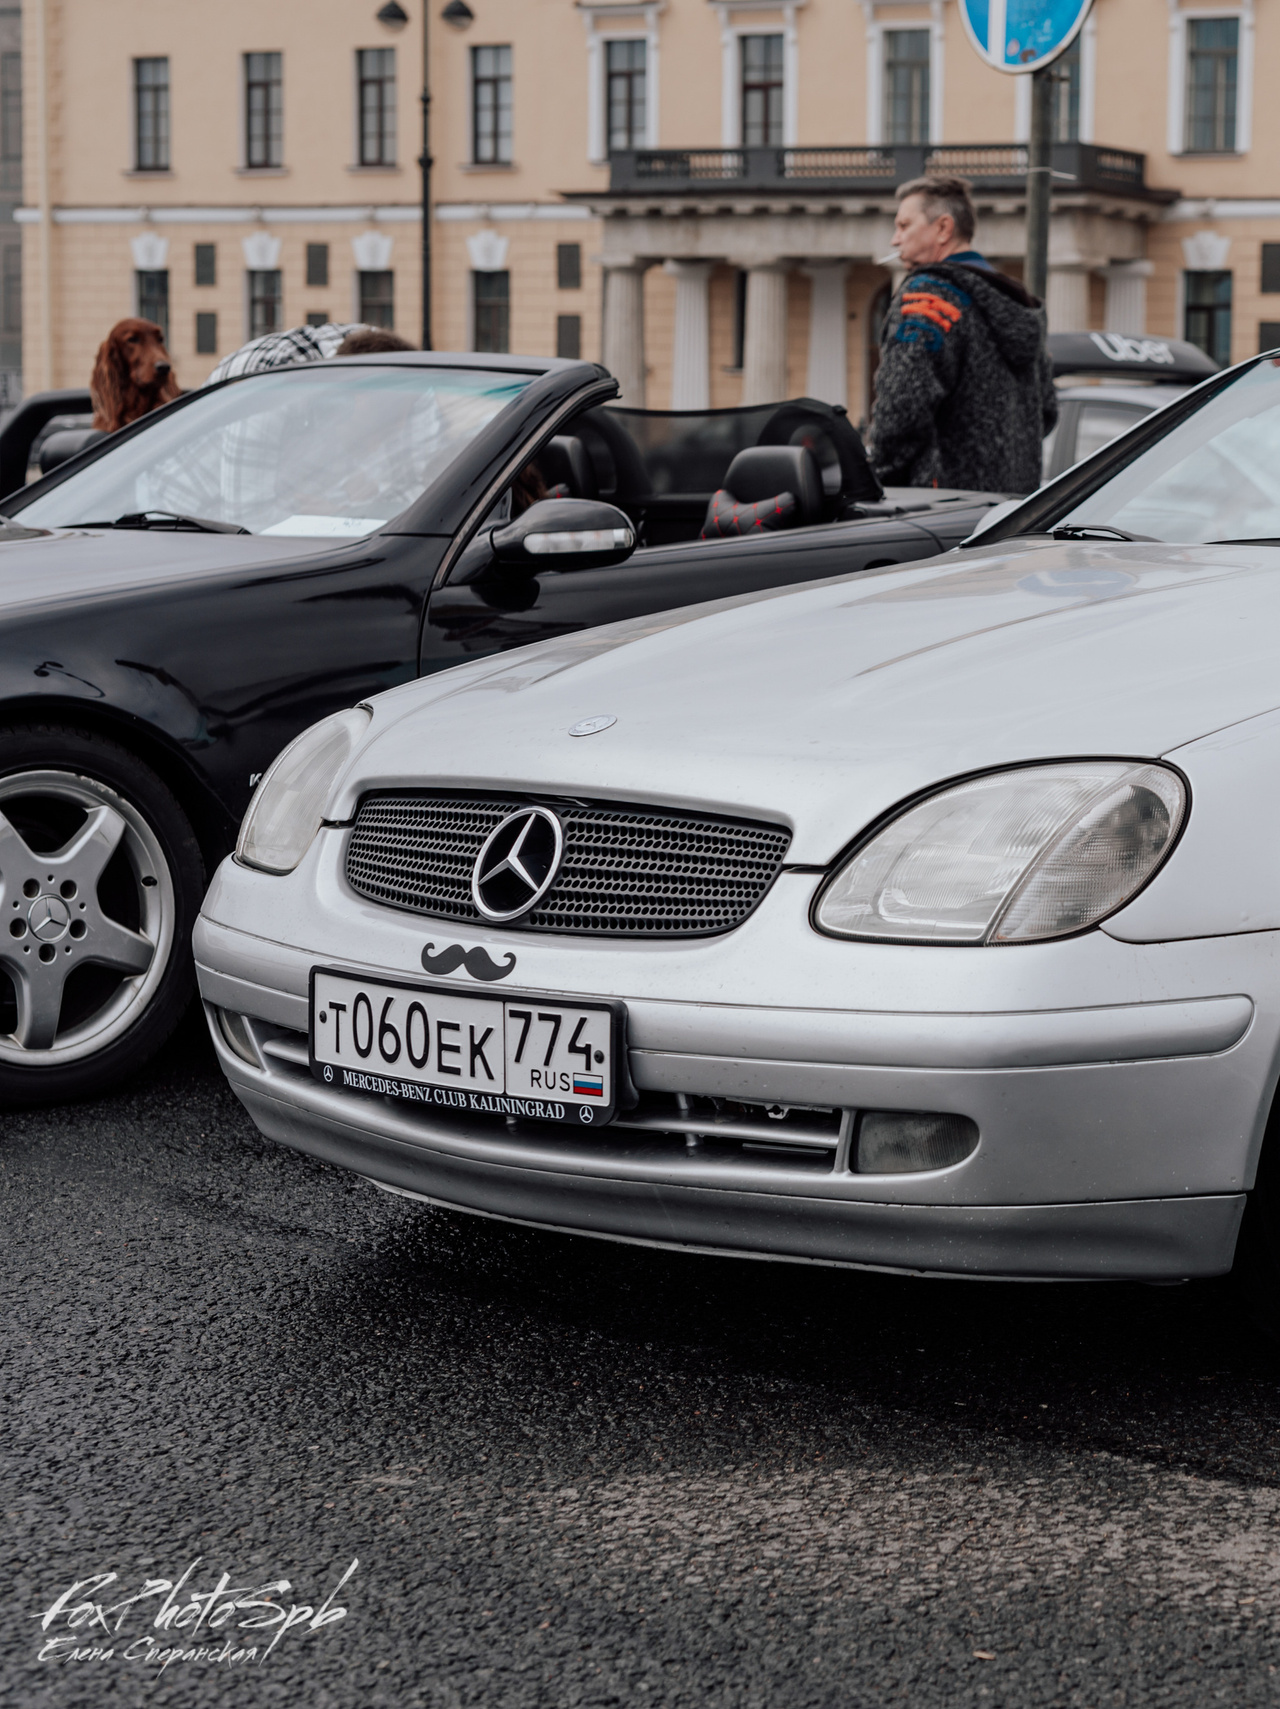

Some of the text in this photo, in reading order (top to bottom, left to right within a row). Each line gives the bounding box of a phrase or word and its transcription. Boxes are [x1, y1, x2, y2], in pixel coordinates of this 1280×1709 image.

[1089, 332, 1175, 365] Uber
[508, 1009, 592, 1071] 774
[342, 1069, 565, 1120] MERCEDES-BENZ CLUB KALININGRAD
[530, 1069, 571, 1092] RUS
